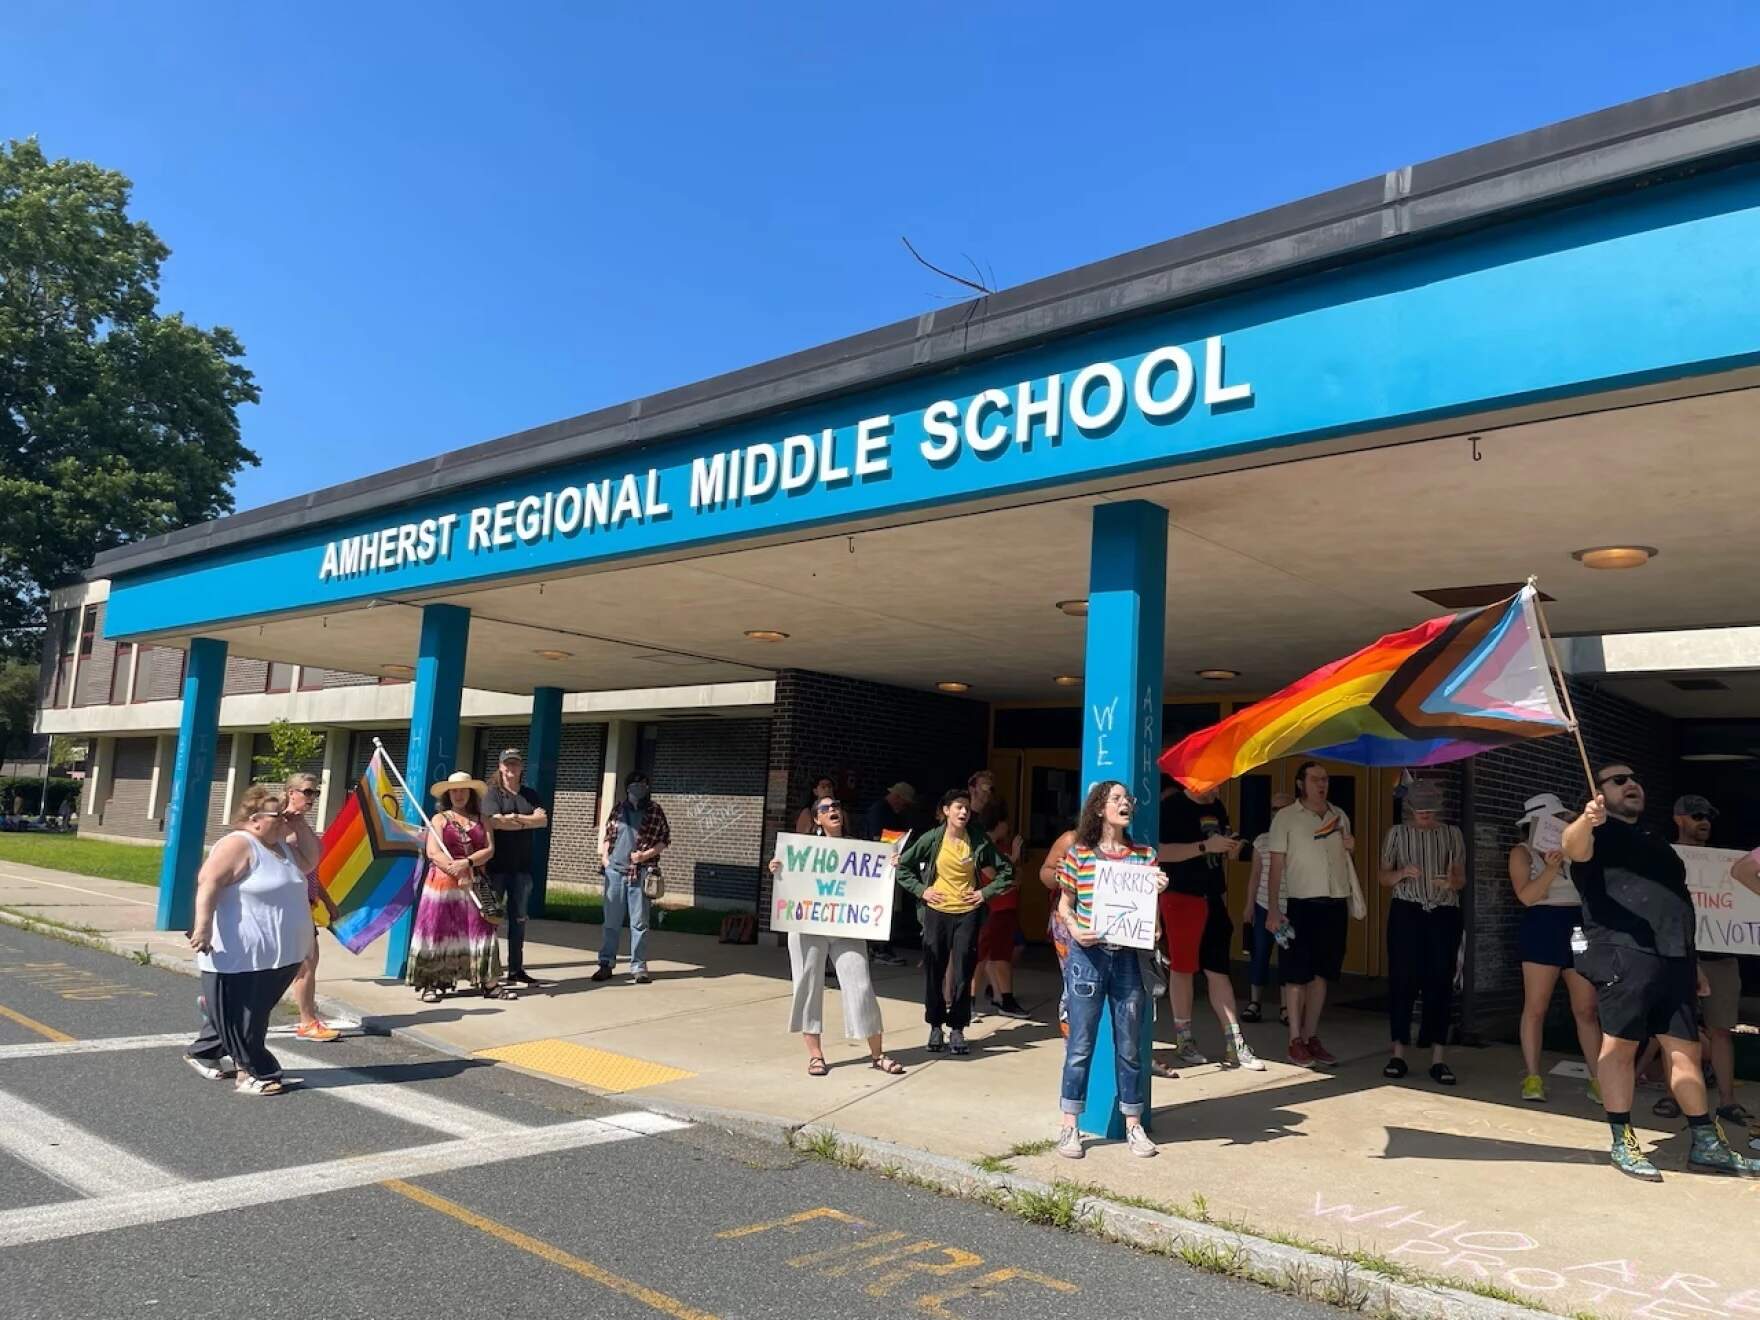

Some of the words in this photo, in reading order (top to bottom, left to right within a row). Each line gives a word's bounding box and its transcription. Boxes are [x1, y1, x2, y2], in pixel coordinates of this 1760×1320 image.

[319, 513, 457, 579] AMHERST
[468, 468, 670, 550] REGIONAL
[690, 414, 891, 507] MIDDLE
[920, 335, 1252, 462] SCHOOL
[1093, 696, 1119, 766] WE
[786, 845, 840, 873] WHO
[840, 851, 886, 878] ARE
[816, 879, 847, 897] WE
[1097, 866, 1155, 895] MORRIS
[775, 900, 884, 927] PROTECTING?
[1690, 892, 1733, 909] TING
[1716, 919, 1760, 947] VOT
[1311, 1192, 1540, 1252] WHO
